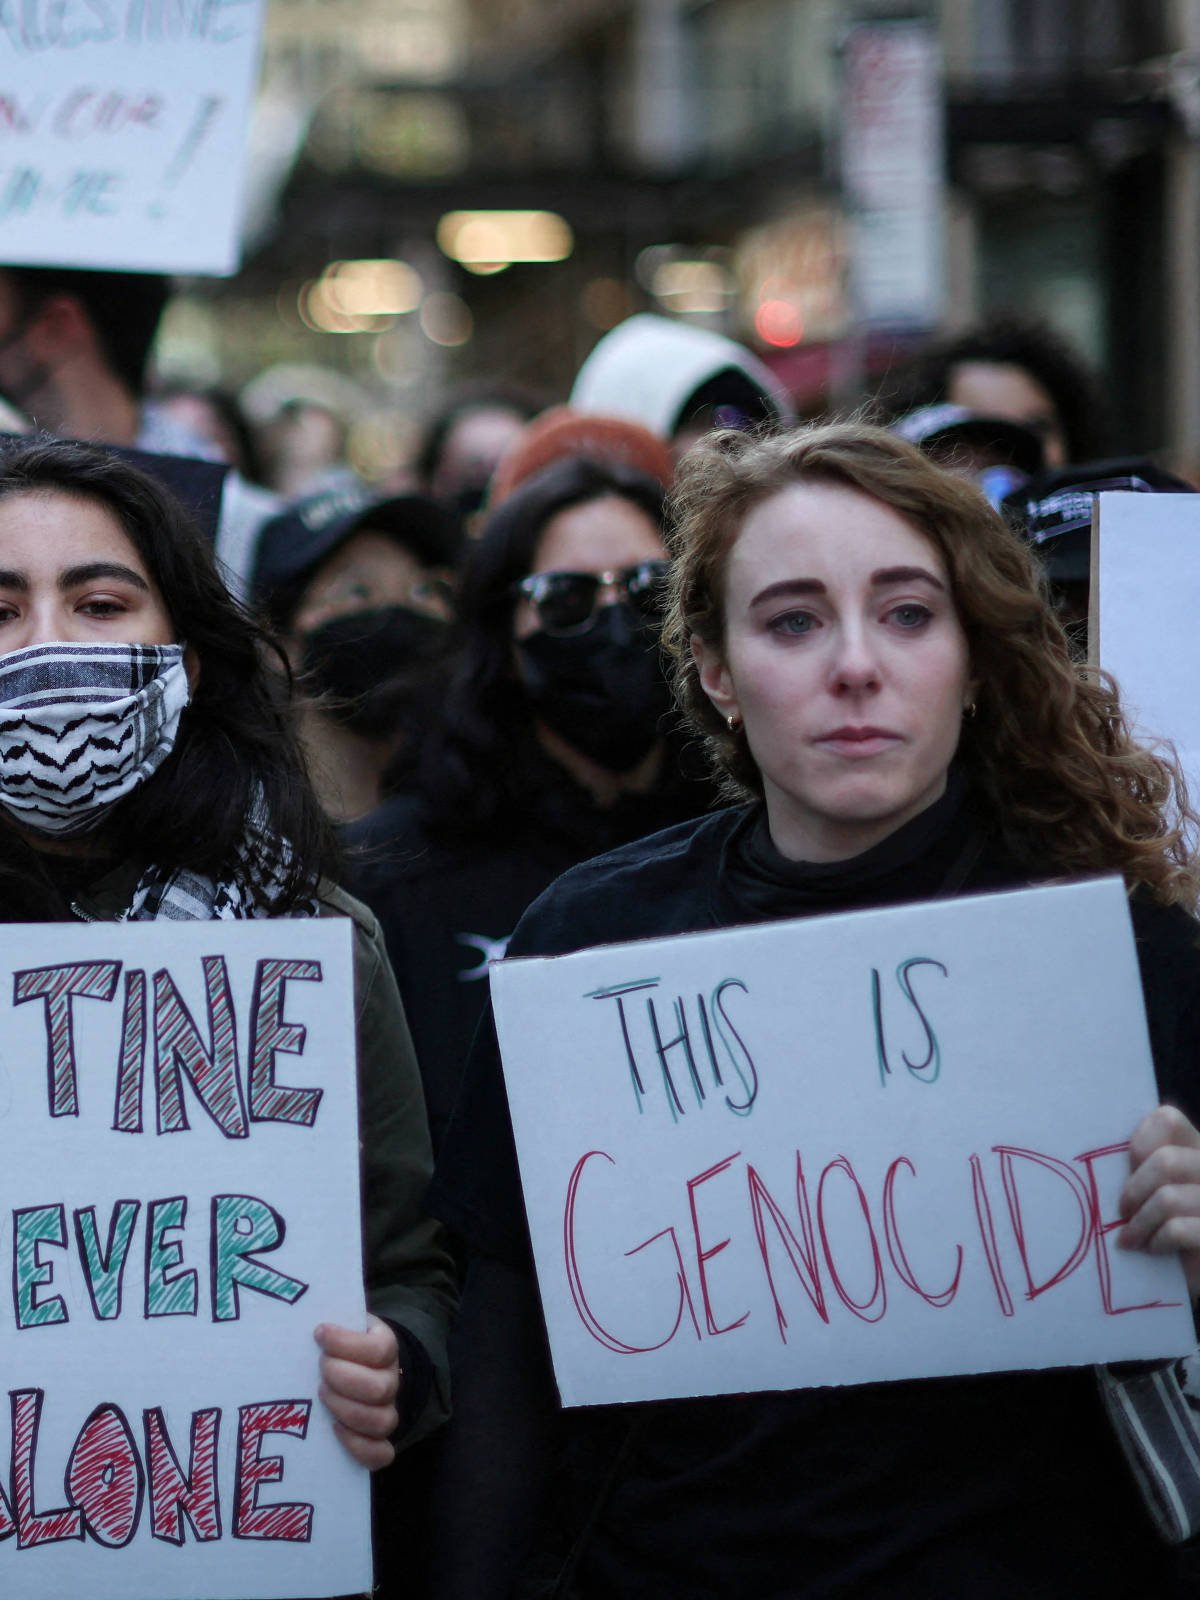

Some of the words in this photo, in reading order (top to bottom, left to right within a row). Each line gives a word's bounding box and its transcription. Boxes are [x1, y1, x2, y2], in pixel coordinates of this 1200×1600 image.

[583, 976, 759, 1124] THIS
[870, 956, 949, 1088] IS
[563, 1141, 1184, 1355] GENOCIDE
